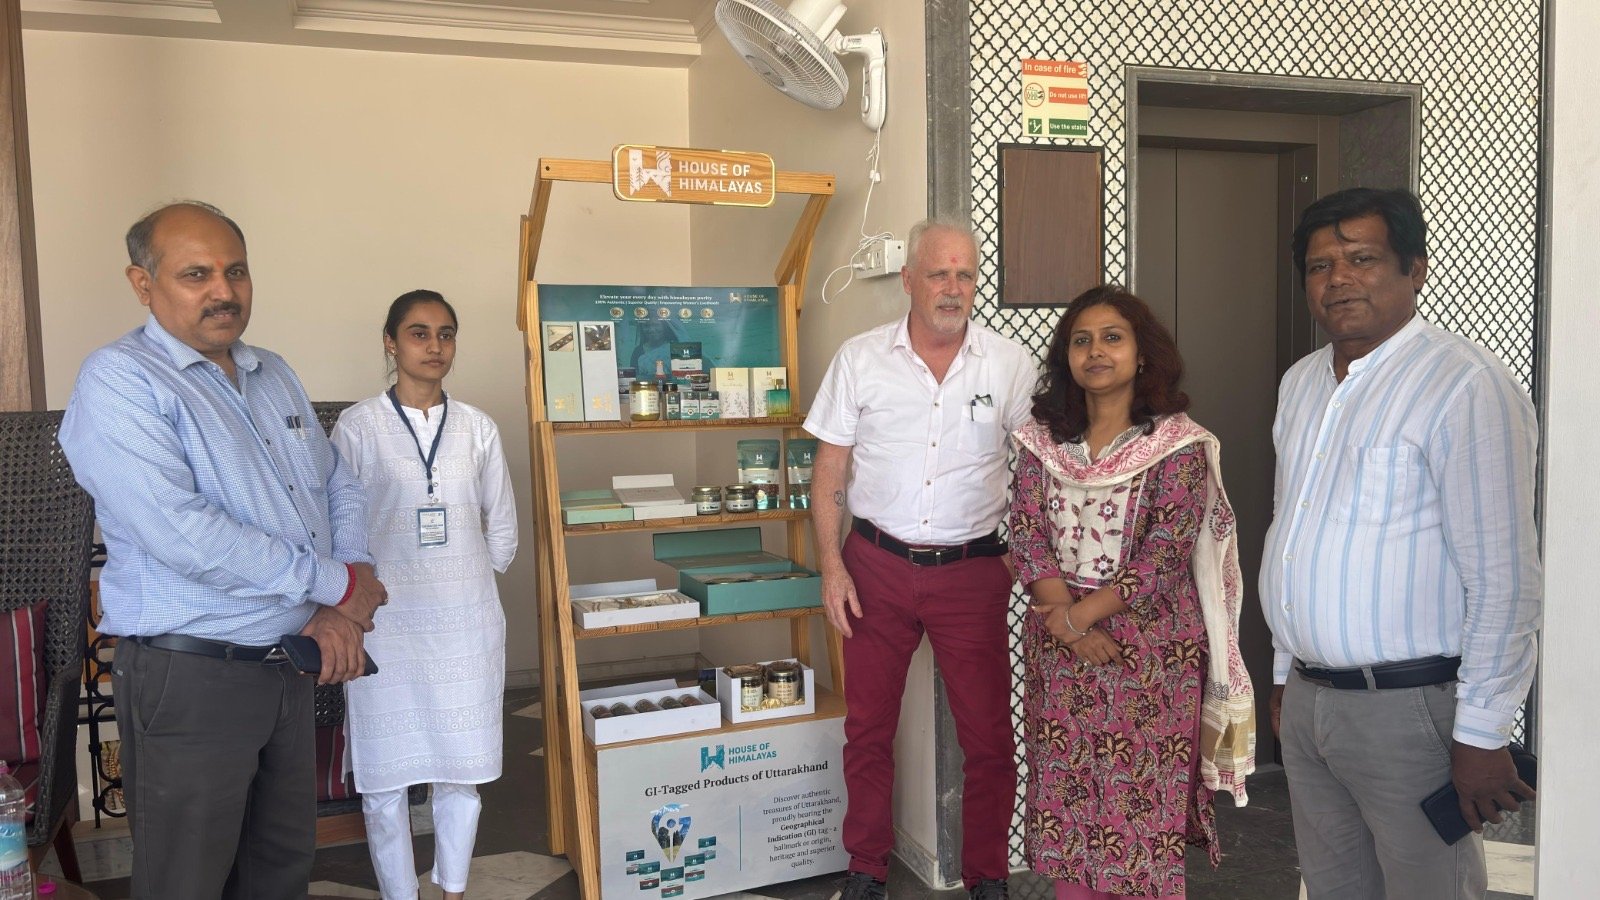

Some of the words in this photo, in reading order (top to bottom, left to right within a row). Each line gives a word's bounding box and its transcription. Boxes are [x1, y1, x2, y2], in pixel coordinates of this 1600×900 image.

[1024, 62, 1033, 71] In
[1034, 64, 1053, 72] case
[1054, 65, 1062, 73] of
[1063, 65, 1077, 74] fire
[678, 160, 728, 176] HOUSE
[732, 164, 751, 177] OF
[679, 177, 763, 194] HIMALAYAS
[728, 744, 757, 756] HOUSE
[759, 742, 771, 751] OF
[728, 750, 778, 765] HIMALAYAS
[644, 780, 701, 797] GI-Tagged
[703, 773, 750, 789] Products
[751, 770, 764, 781] of
[765, 760, 829, 779] Uttarakhand
[773, 793, 801, 804] Discover
[801, 787, 832, 799] authentic
[763, 805, 793, 815] treasures
[793, 802, 801, 810] of
[772, 813, 797, 824] proudly
[797, 809, 822, 819] bearing
[822, 807, 833, 815] the
[780, 817, 825, 831] Geographical
[767, 832, 803, 843] Indication
[803, 828, 817, 838] (GI)
[818, 827, 829, 835] tag
[773, 840, 802, 852] hallmark
[769, 853, 796, 863] heritage
[796, 849, 809, 857] and
[809, 845, 836, 855] superior
[790, 858, 815, 869] quality.
